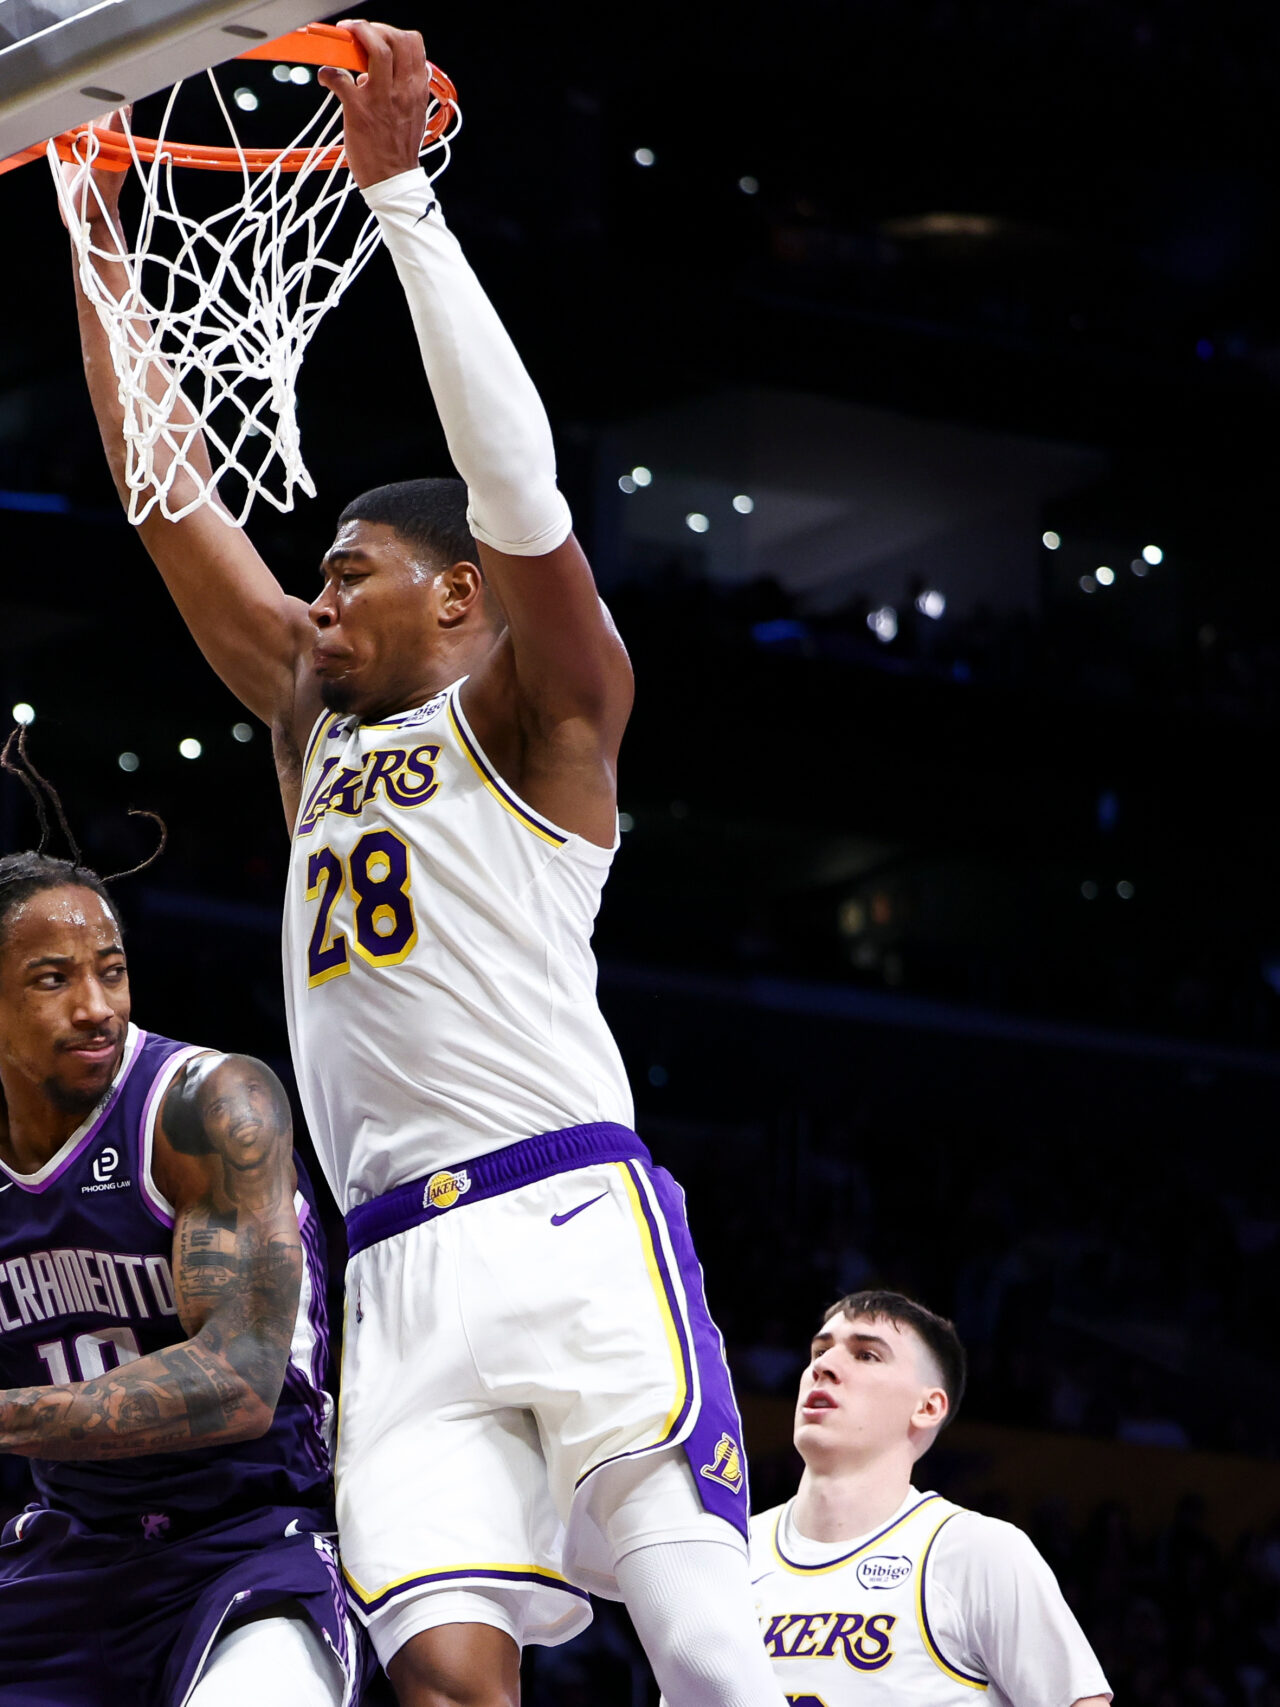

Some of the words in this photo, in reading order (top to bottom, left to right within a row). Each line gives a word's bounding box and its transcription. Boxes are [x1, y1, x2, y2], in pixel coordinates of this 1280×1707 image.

[304, 828, 418, 990] 28
[81, 1182, 116, 1194] PHOONG
[116, 1180, 131, 1188] LAW
[424, 1177, 466, 1206] LAKERS
[862, 1563, 910, 1580] bibigo
